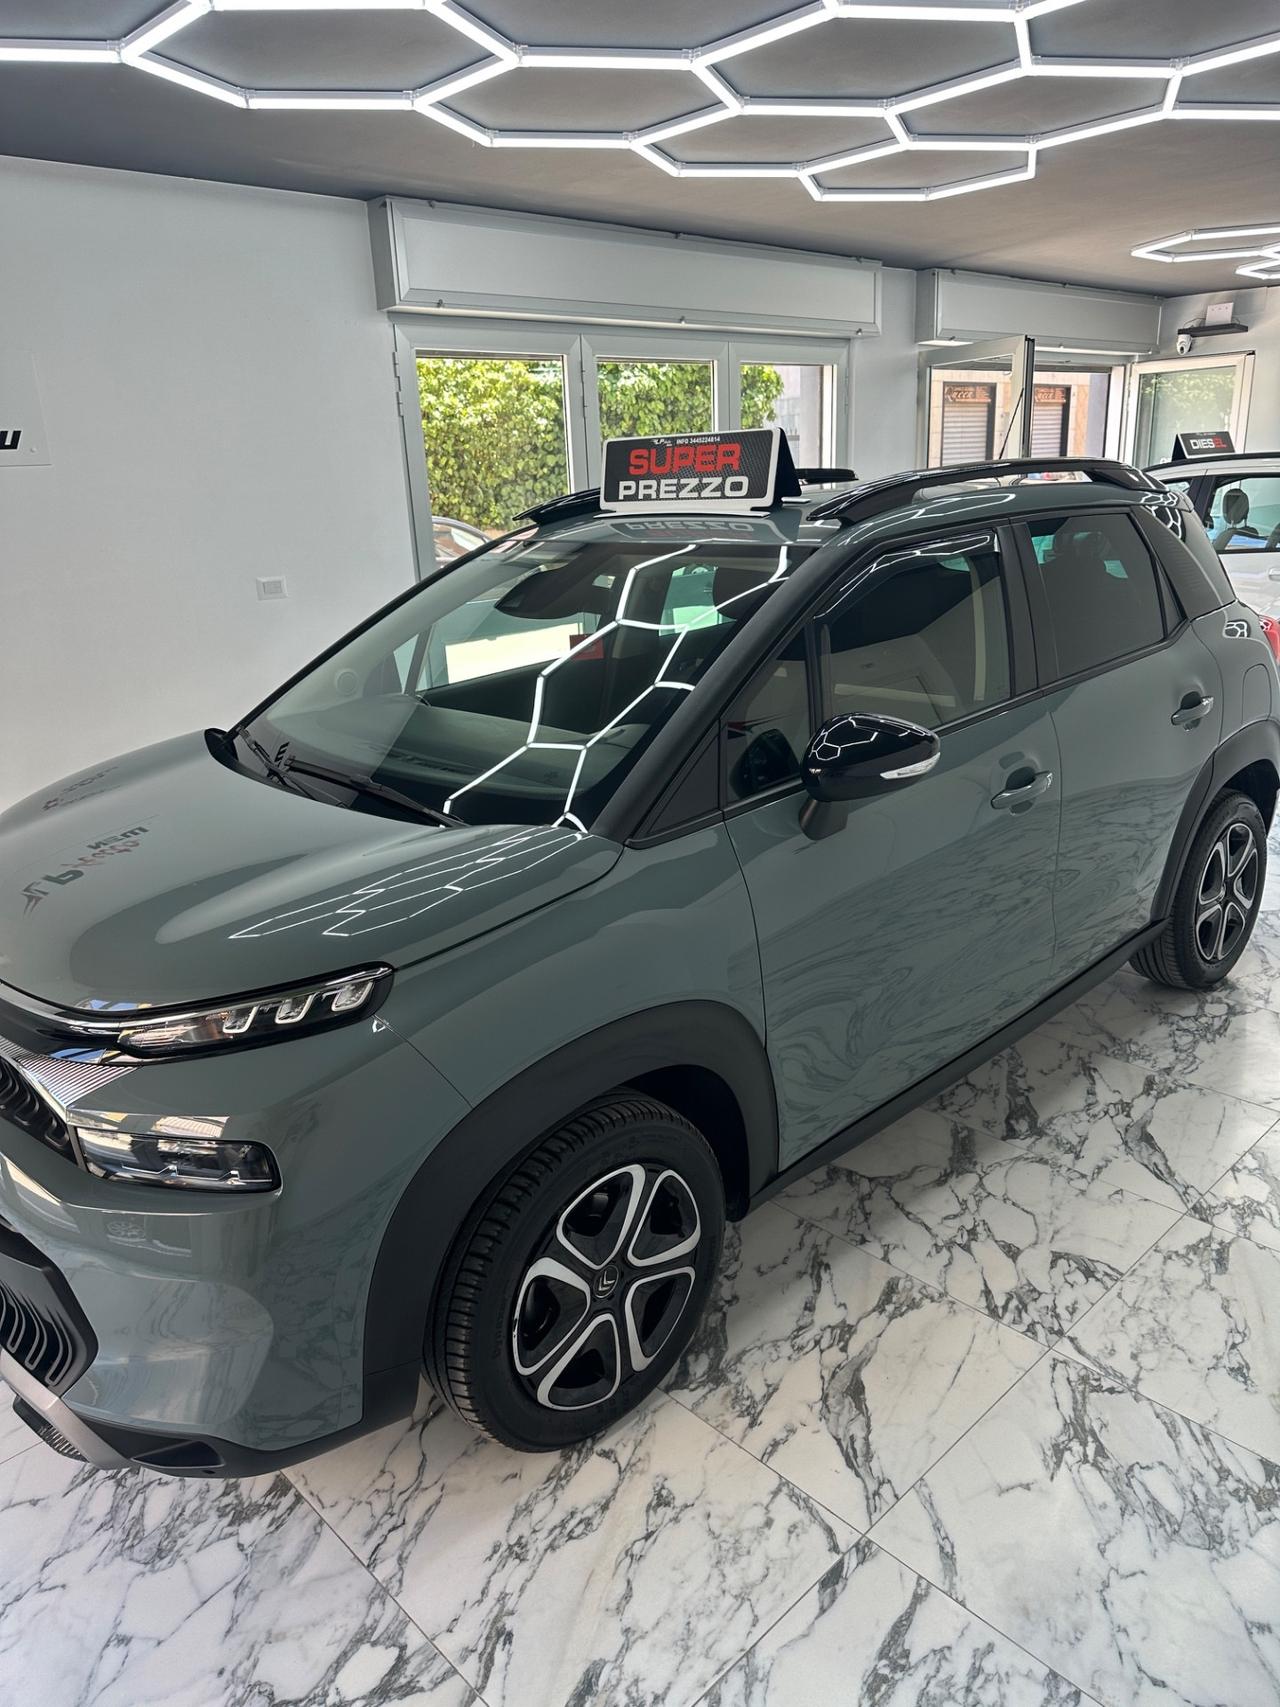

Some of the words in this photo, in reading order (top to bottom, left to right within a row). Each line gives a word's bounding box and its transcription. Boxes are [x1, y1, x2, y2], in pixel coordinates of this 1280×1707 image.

[1190, 437, 1227, 449] DIESEL
[629, 444, 741, 475] SUPER
[618, 476, 749, 500] PREZZO
